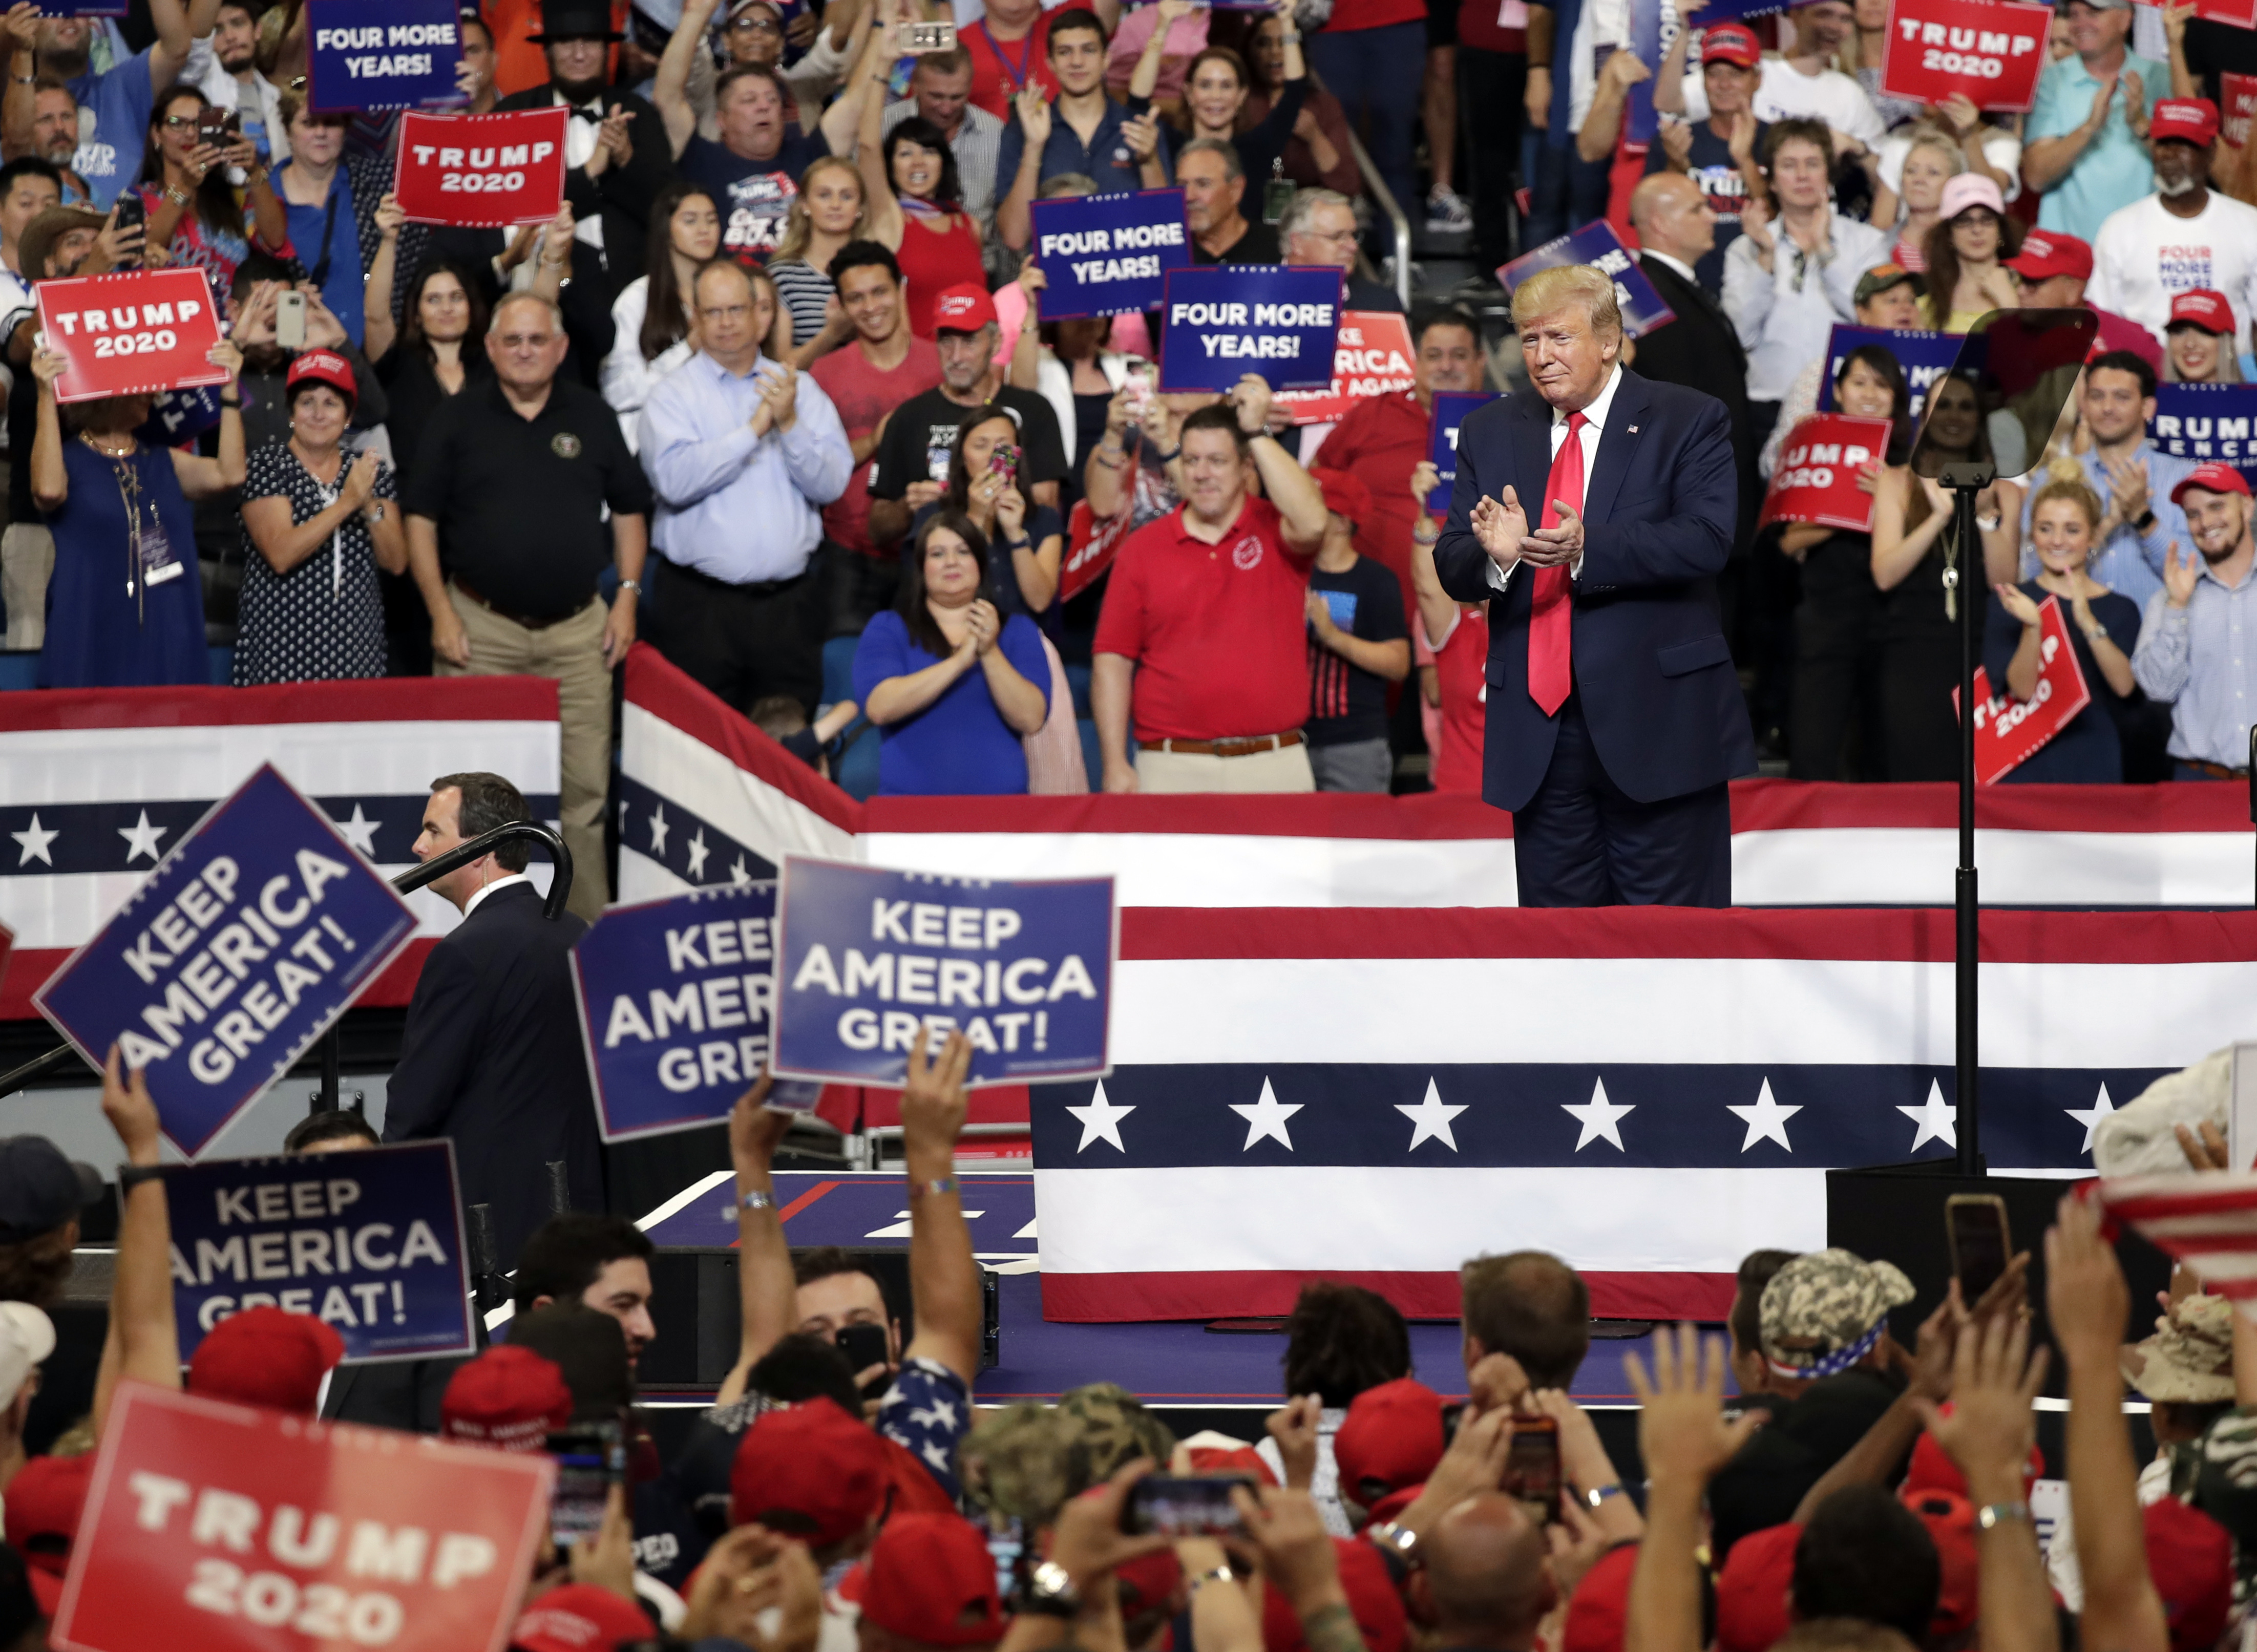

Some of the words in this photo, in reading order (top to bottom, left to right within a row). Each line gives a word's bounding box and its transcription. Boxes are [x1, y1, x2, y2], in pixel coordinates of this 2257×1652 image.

[316, 27, 384, 51] FOUR
[388, 24, 457, 47] MORE
[1899, 18, 2036, 57] TRUMP
[345, 53, 432, 78] YEARS!
[1922, 48, 2003, 79] 2020
[412, 141, 554, 168] TRUMP
[440, 171, 525, 193] 2020
[1040, 229, 1110, 258] FOUR
[1113, 222, 1185, 249] MORE
[2159, 246, 2212, 260] FOUR
[1071, 255, 1161, 285] YEARS!
[2159, 261, 2212, 273] MORE
[55, 300, 201, 335] TRUMP
[1171, 303, 1249, 327] FOUR
[1254, 303, 1334, 327] MORE
[94, 330, 177, 358] 2020
[1200, 334, 1301, 359] YEARS!
[1336, 327, 1365, 347] KE
[1333, 348, 1413, 375] RICA
[2155, 414, 2257, 441] RUM
[1787, 442, 1871, 469] UMP
[1776, 467, 1834, 490] 020
[122, 855, 240, 984] KEEP
[872, 898, 1022, 949] KEEP
[118, 848, 350, 1070] AMERICA
[665, 917, 777, 973] KEE
[792, 944, 1098, 1008] AMERICA
[188, 915, 356, 1085] GREAT!
[604, 972, 773, 1048] AMER
[837, 1008, 1048, 1055] GREAT!
[657, 1034, 768, 1093] GRE
[215, 1179, 361, 1225] KEEP
[129, 1470, 498, 1589] TRUMP
[185, 1559, 404, 1646] 2020
